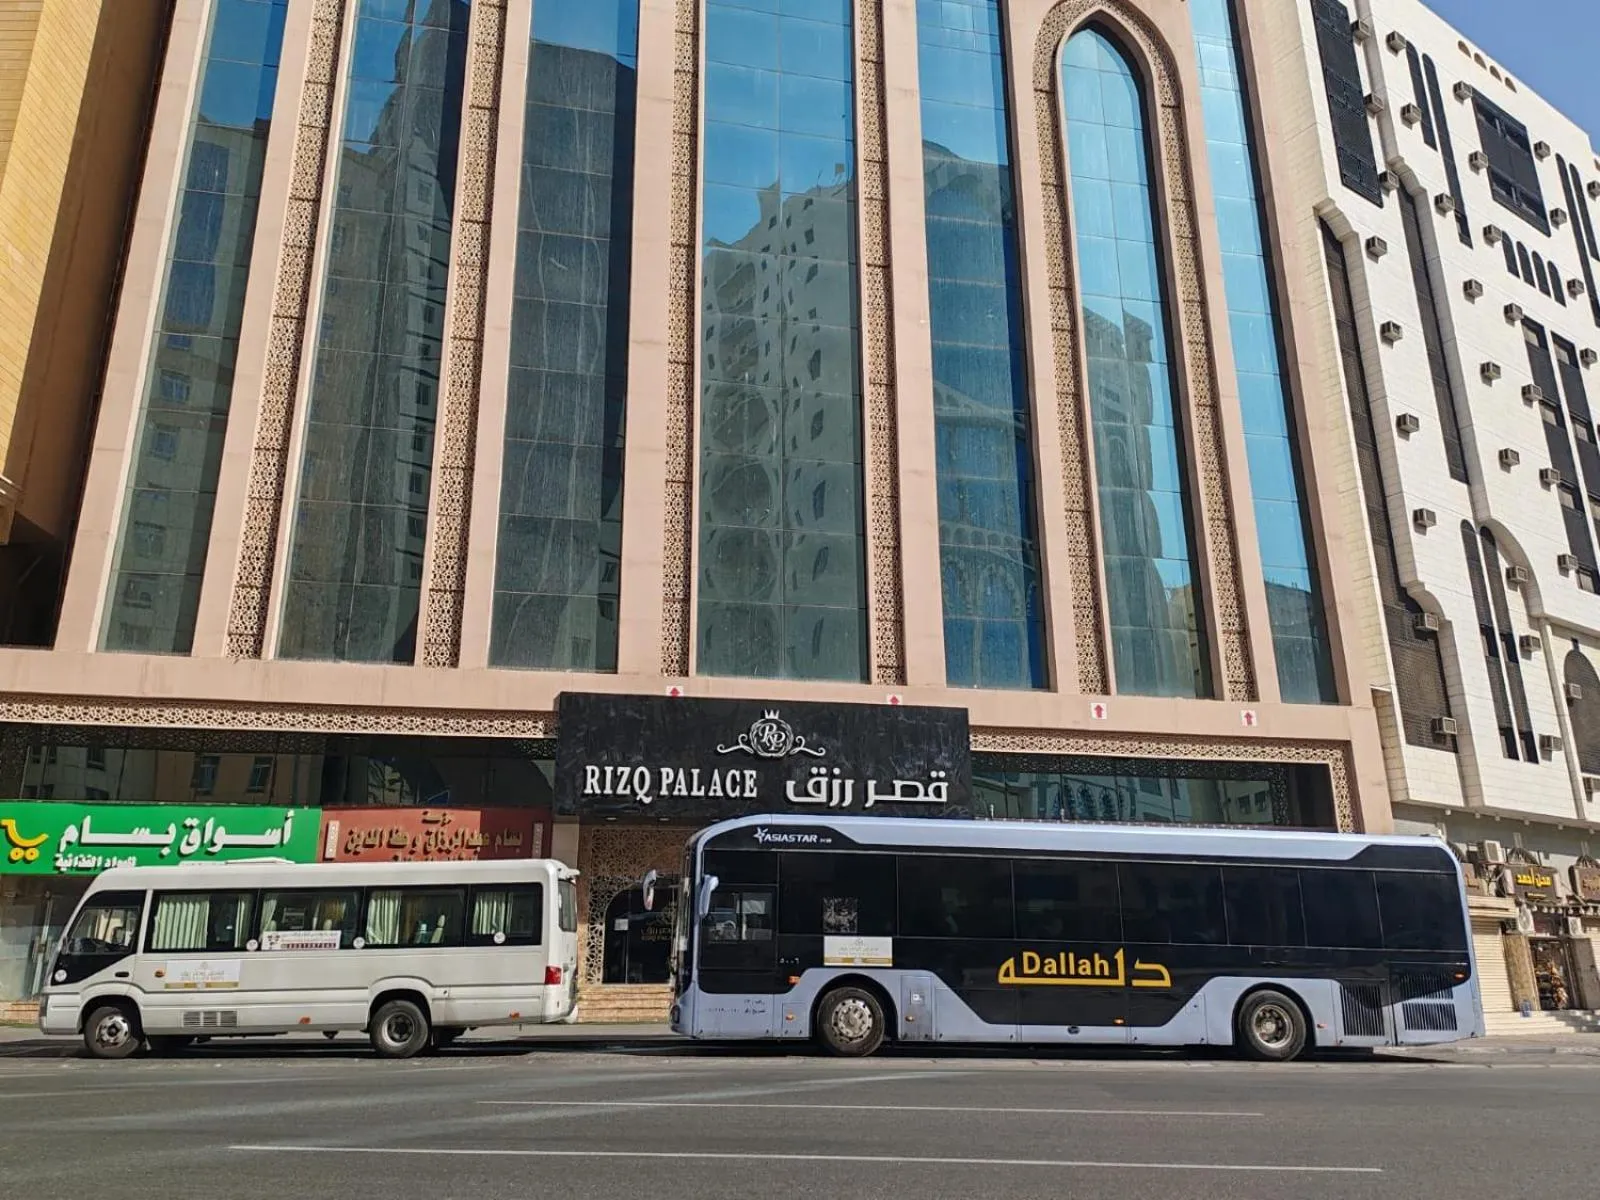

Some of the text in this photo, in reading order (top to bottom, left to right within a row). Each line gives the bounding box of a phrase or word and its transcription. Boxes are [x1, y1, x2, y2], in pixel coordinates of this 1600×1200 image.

[584, 765, 758, 804] RIZQ PALACE
[786, 767, 949, 808] قصر رزق
[59, 810, 295, 856] أسواق بسام
[494, 828, 523, 853] بسام
[763, 833, 818, 843] ASIASTAR
[1022, 951, 1110, 976] Dallah
